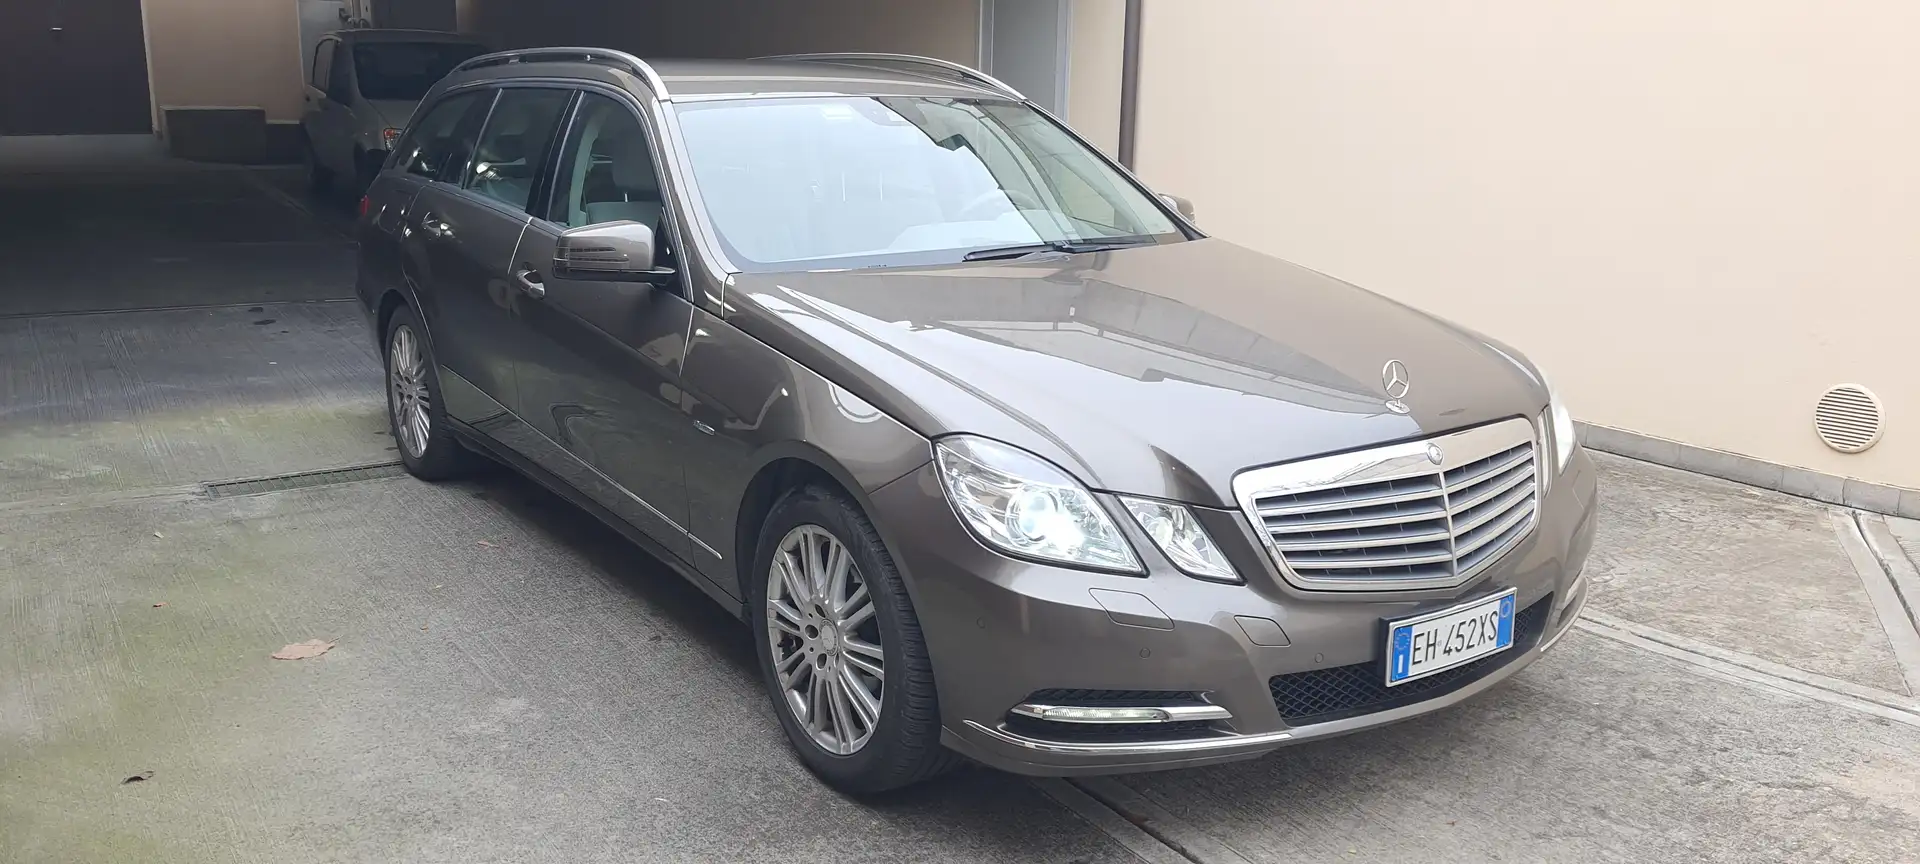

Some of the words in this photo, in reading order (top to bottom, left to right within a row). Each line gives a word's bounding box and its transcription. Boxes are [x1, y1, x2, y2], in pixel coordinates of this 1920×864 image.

[1412, 628, 1438, 666] EH
[1443, 610, 1498, 656] 452XS
[1397, 654, 1404, 674] I
